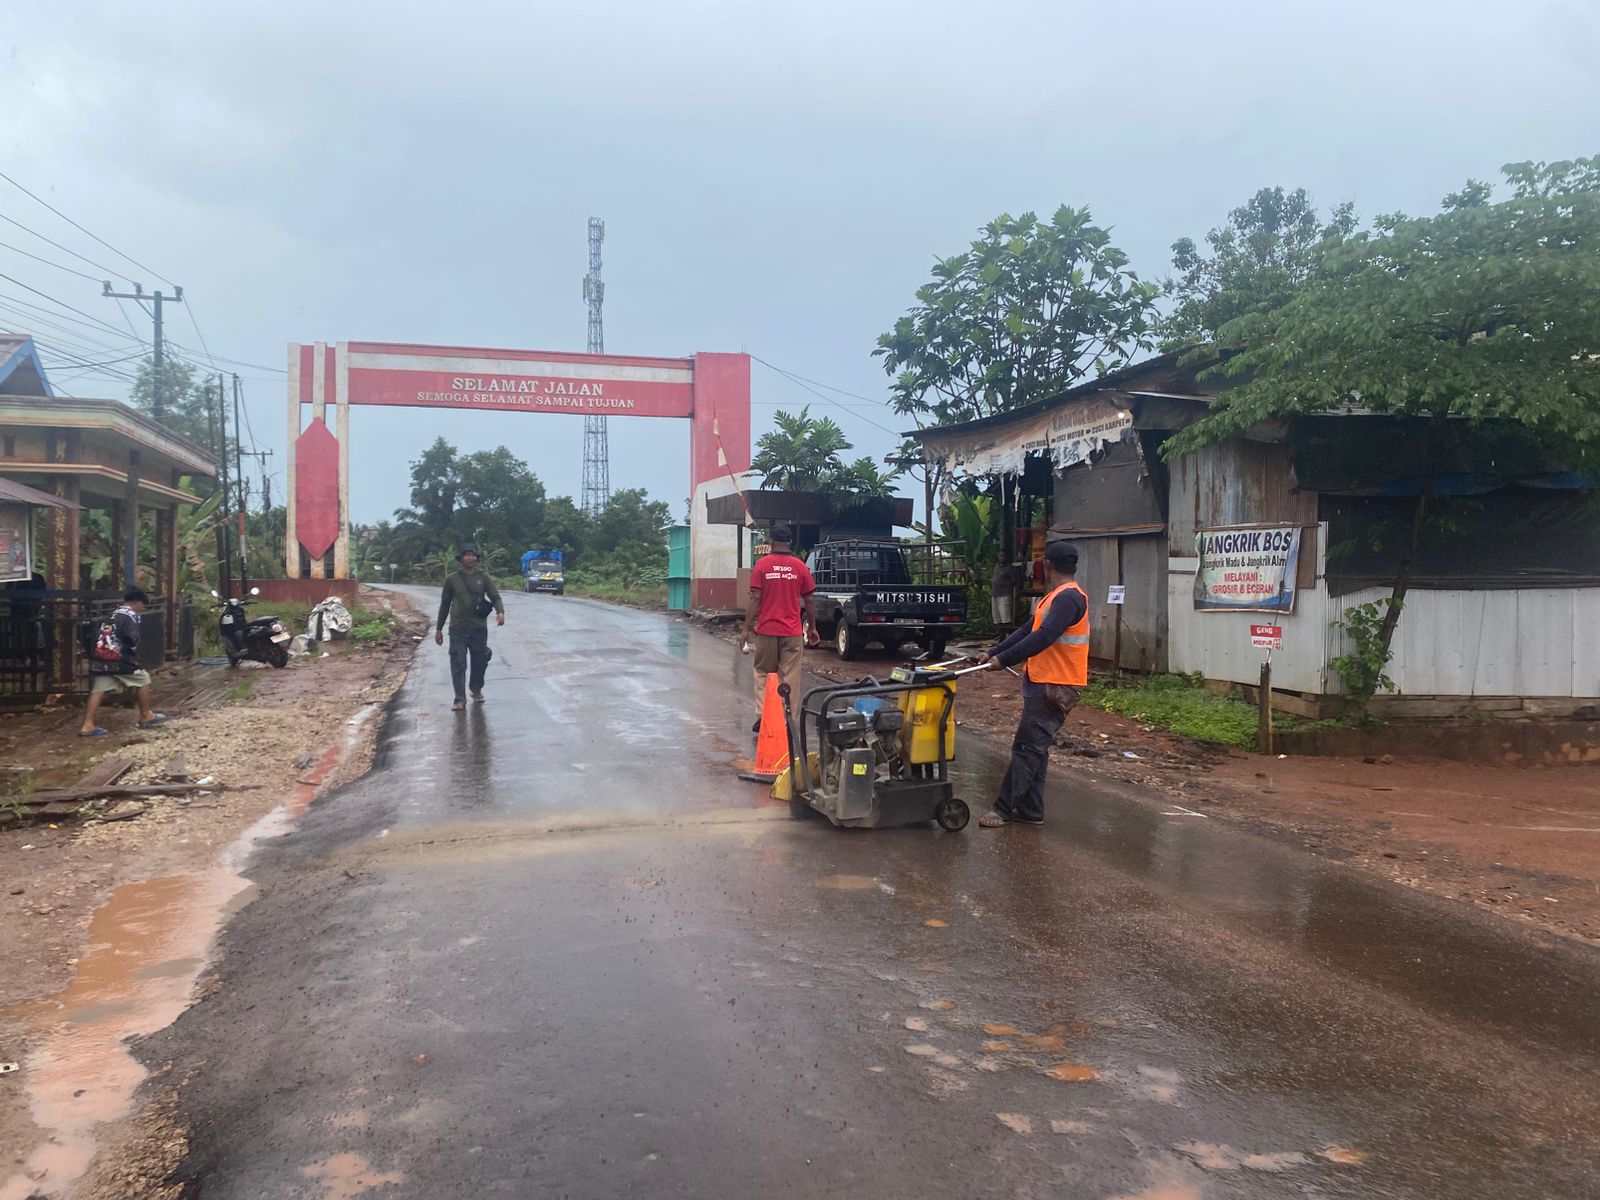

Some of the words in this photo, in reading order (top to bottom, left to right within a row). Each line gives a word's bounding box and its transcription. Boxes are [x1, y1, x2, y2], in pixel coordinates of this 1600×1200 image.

[452, 378, 539, 394] SELAMAT
[544, 381, 604, 396] JALAN
[417, 391, 470, 403] SEMOGA
[473, 393, 533, 405] SELAMAT
[536, 396, 584, 408] SAMPAI
[587, 398, 635, 409] TUJUAN
[1067, 429, 1084, 440] MOTOR
[1105, 418, 1125, 431] KARPET
[1202, 532, 1262, 555] JANGKRIK
[1263, 531, 1293, 551] BOS
[1225, 556, 1240, 567] Madu
[1240, 556, 1245, 566] &
[1246, 555, 1271, 569] Jangkrik
[1224, 572, 1258, 582] MELAYANI
[1213, 585, 1237, 594] GROSIR
[1247, 584, 1274, 594] ECERAN
